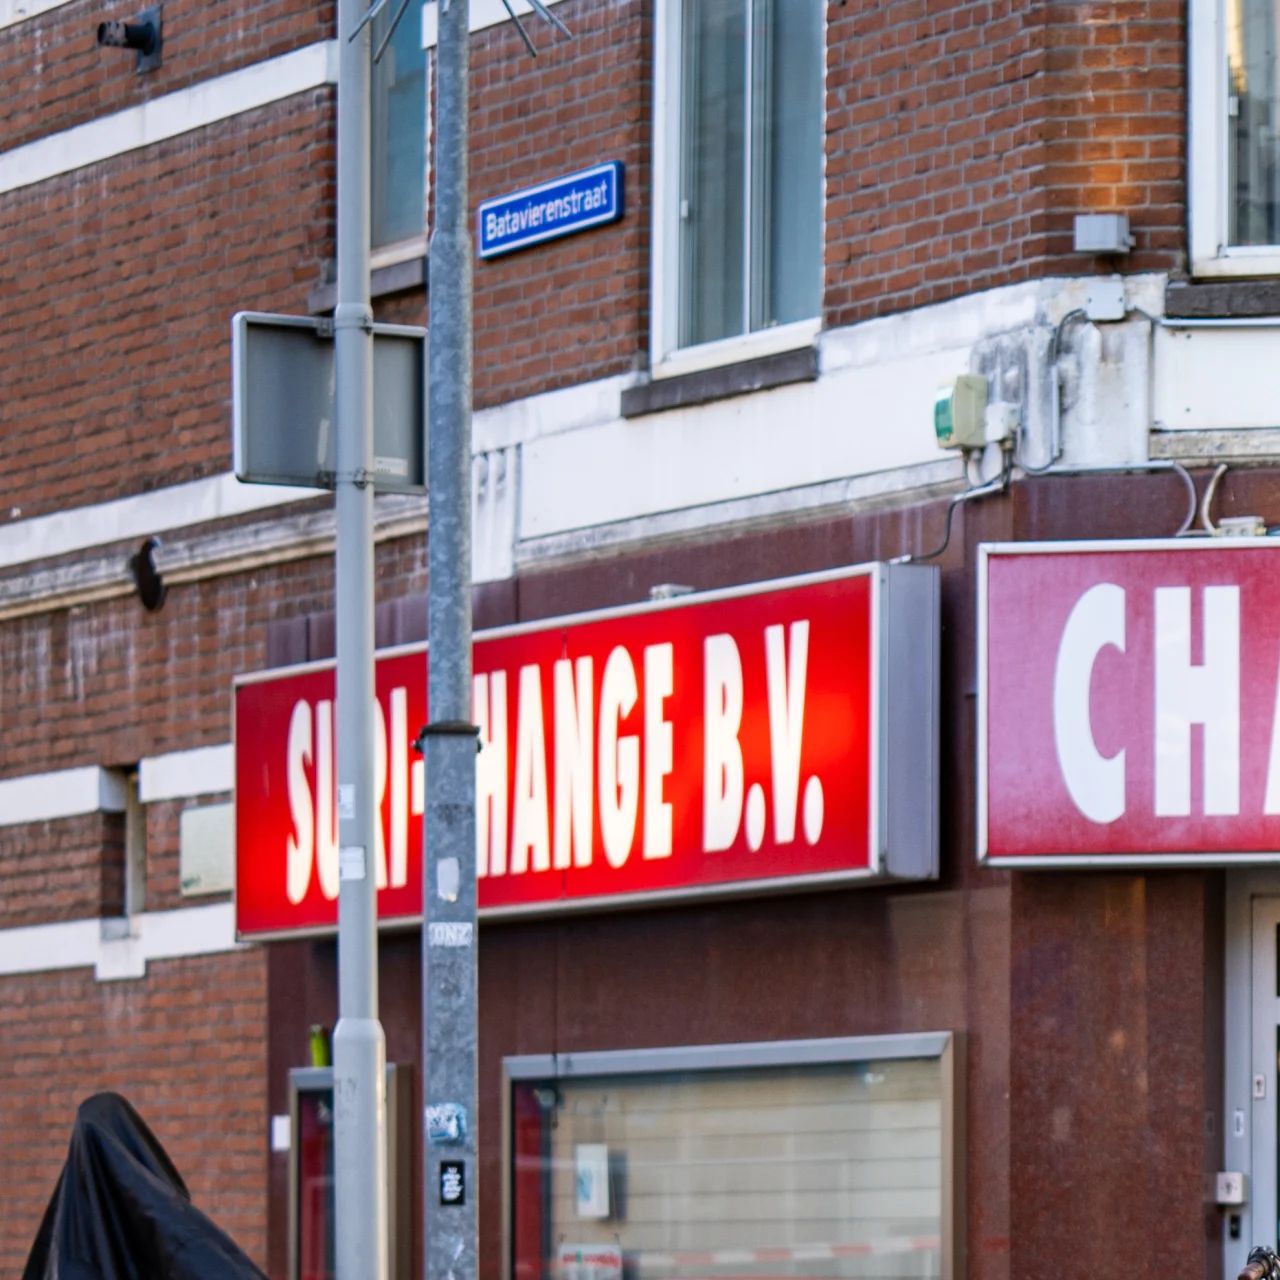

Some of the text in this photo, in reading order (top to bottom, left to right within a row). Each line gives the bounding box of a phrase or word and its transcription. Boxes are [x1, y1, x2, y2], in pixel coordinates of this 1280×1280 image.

[486, 180, 608, 241] Batavierenstraat
[286, 619, 825, 904] SUI-HANGE B.V.
